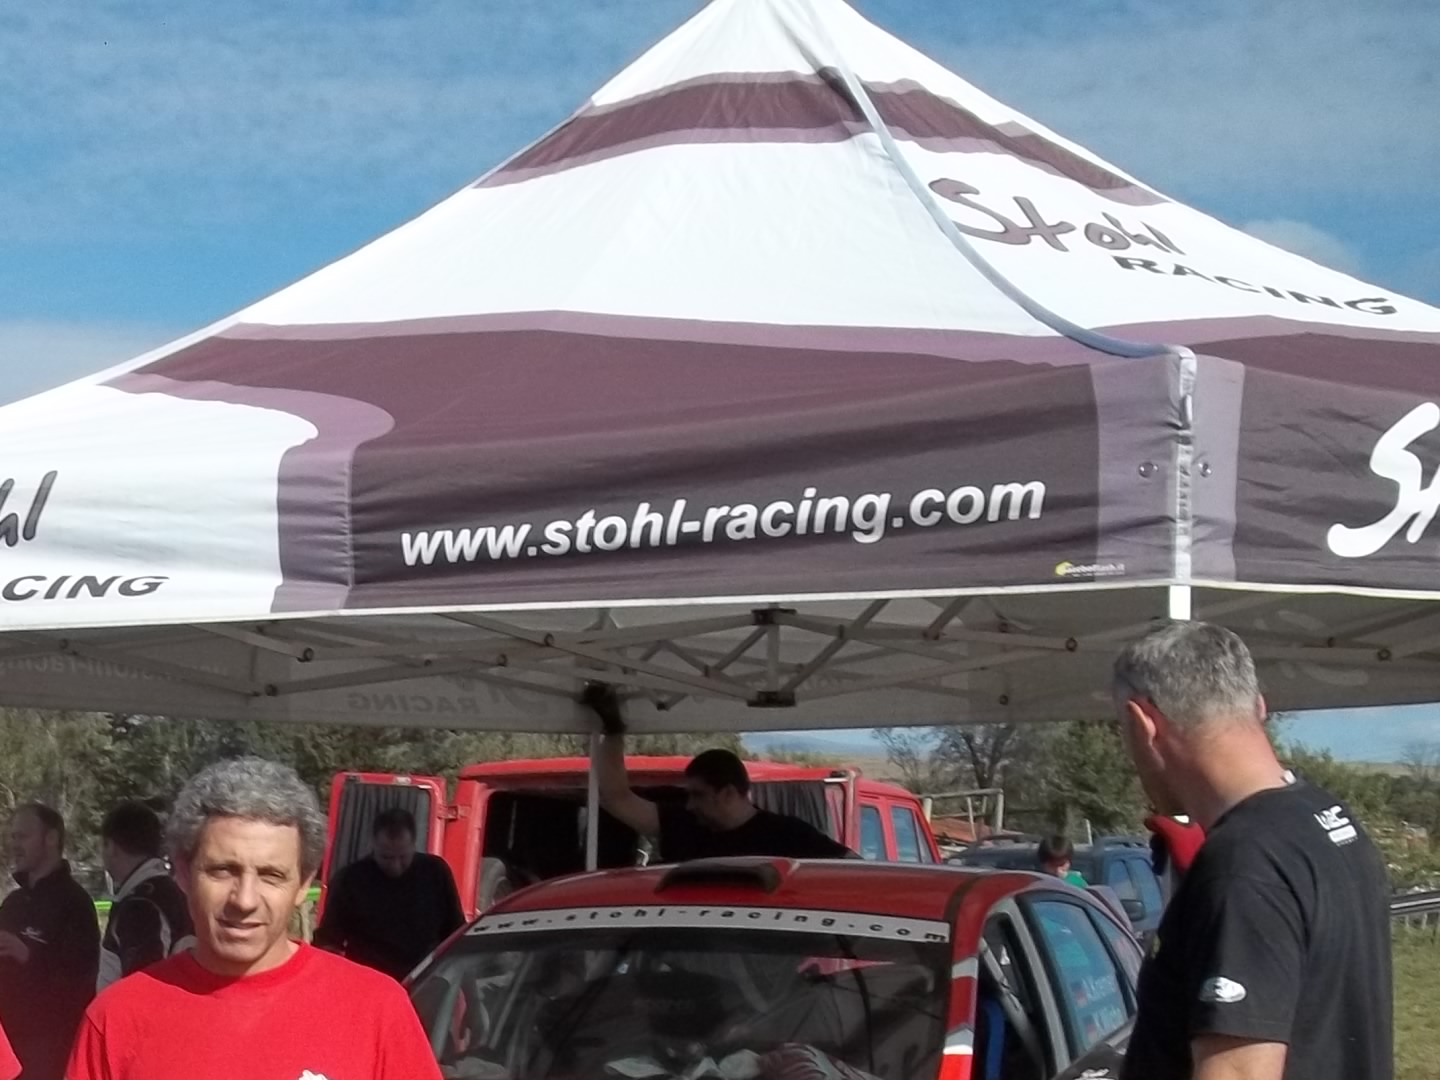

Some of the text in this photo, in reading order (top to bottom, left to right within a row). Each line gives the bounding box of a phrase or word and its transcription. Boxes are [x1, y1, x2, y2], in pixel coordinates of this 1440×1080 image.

[1109, 255, 1398, 314] RACING
[401, 481, 1046, 566] www.stohl-racing.com
[473, 908, 947, 942] www.stohl-racing.com
